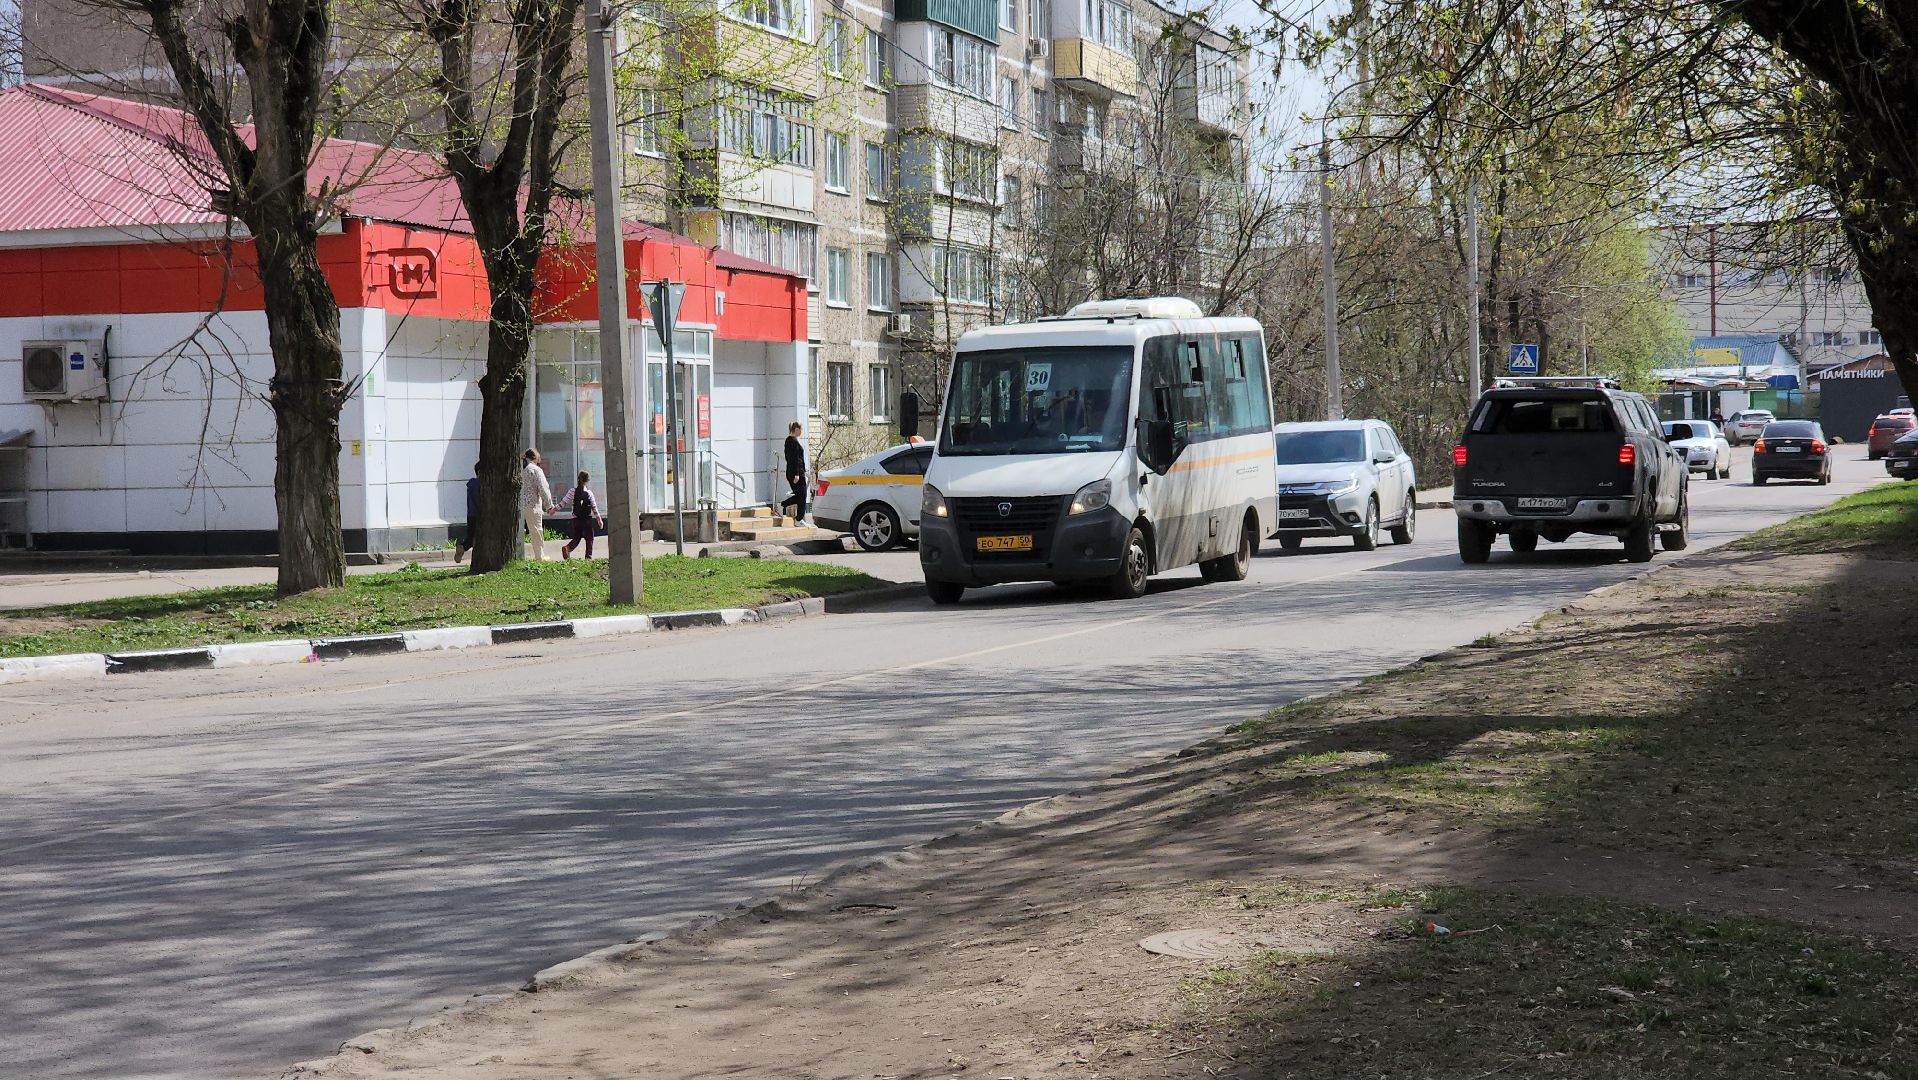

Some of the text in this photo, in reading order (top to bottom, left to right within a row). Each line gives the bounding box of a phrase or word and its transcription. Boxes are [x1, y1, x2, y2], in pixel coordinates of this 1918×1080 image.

[1030, 370, 1048, 386] 30
[1819, 368, 1885, 380] ПАМЯТНИКИ
[996, 537, 1015, 548] 747
